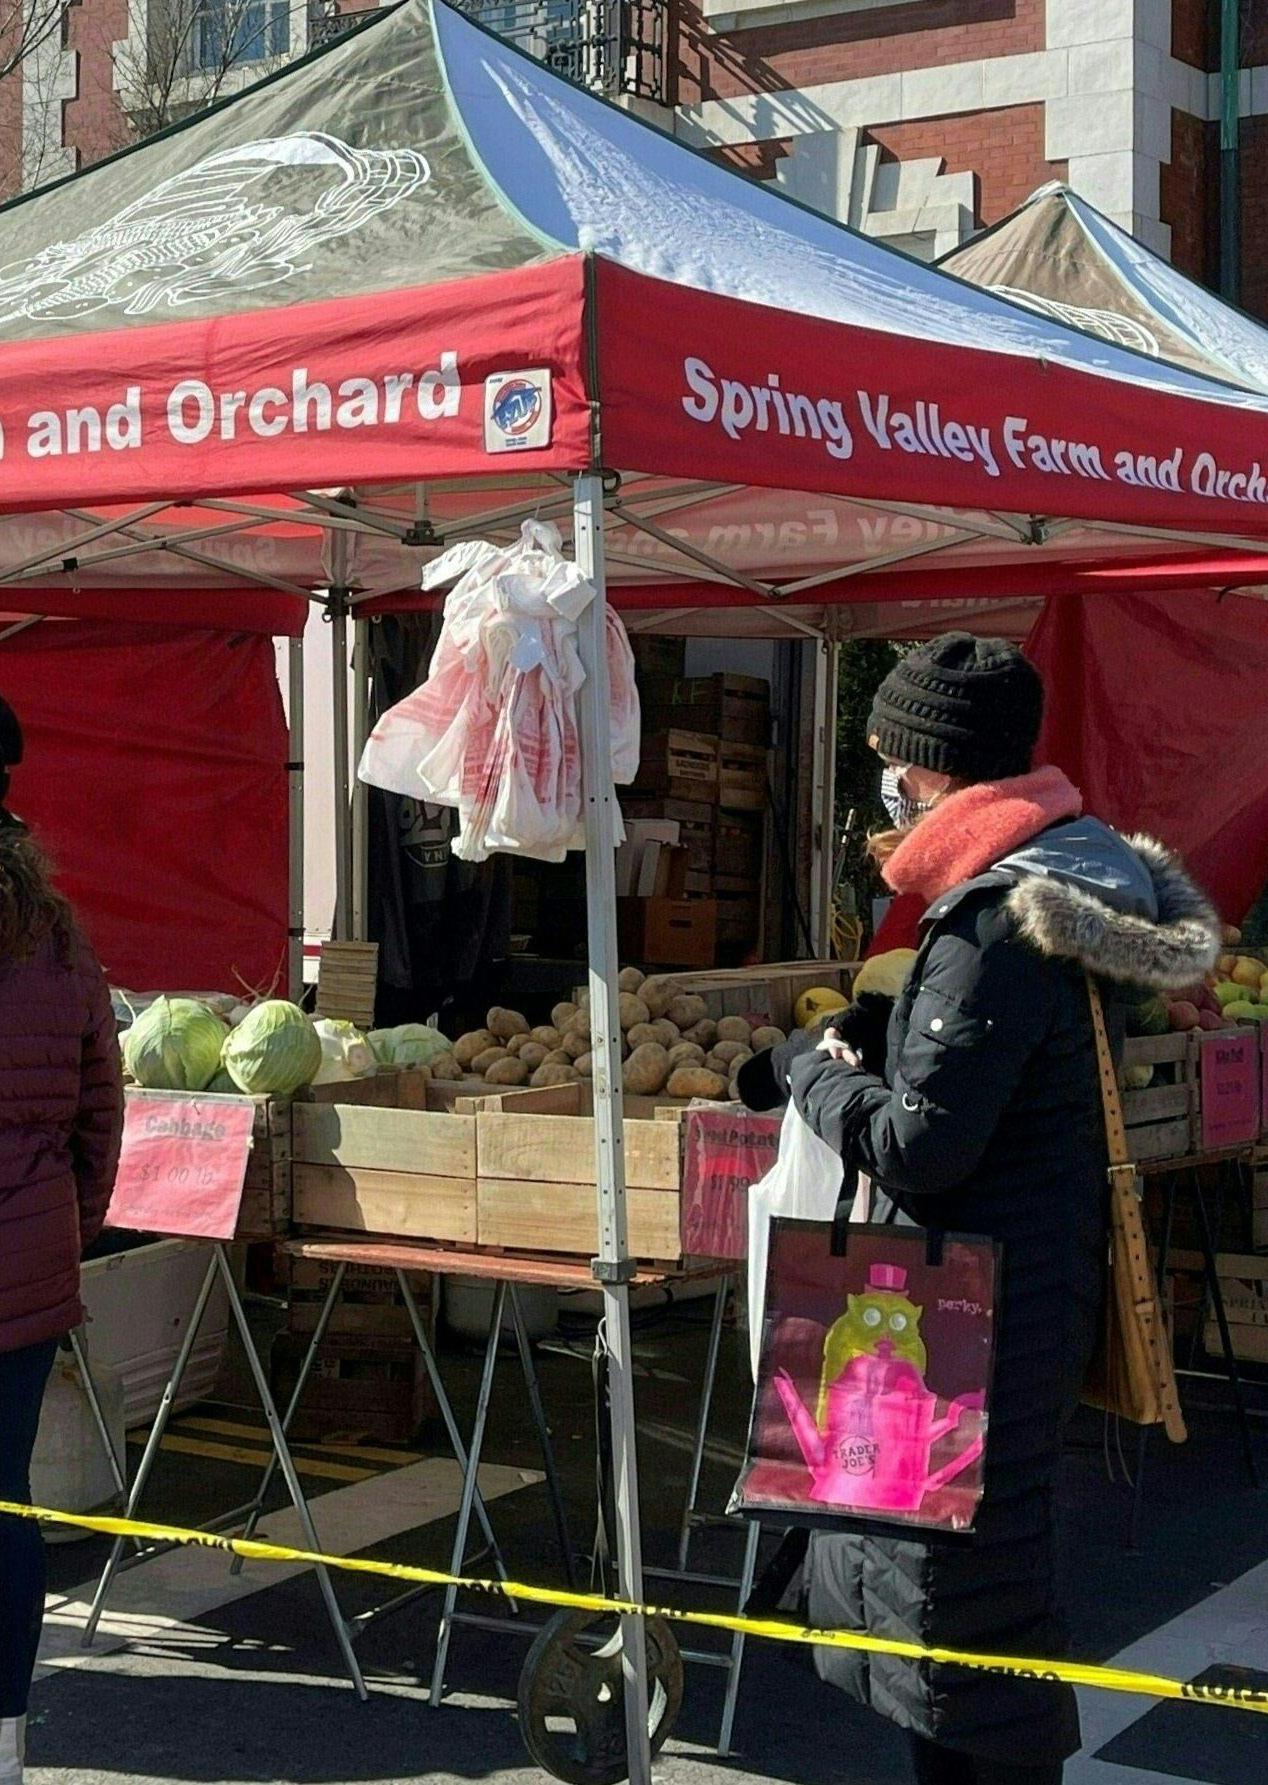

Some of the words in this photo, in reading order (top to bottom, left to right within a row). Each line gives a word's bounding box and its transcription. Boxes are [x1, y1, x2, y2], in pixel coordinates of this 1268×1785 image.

[26, 386, 142, 458] and
[166, 351, 462, 444] Orchard
[682, 356, 853, 460] Spring
[857, 390, 1001, 478] Valley
[1003, 415, 1112, 481] Farm
[1115, 447, 1187, 493] and
[1190, 451, 1268, 504] Orch
[145, 1114, 226, 1140] Cabbage
[729, 1129, 781, 1148] Potat
[832, 1442, 881, 1460] TRADER
[842, 1454, 876, 1473] JOE'S
